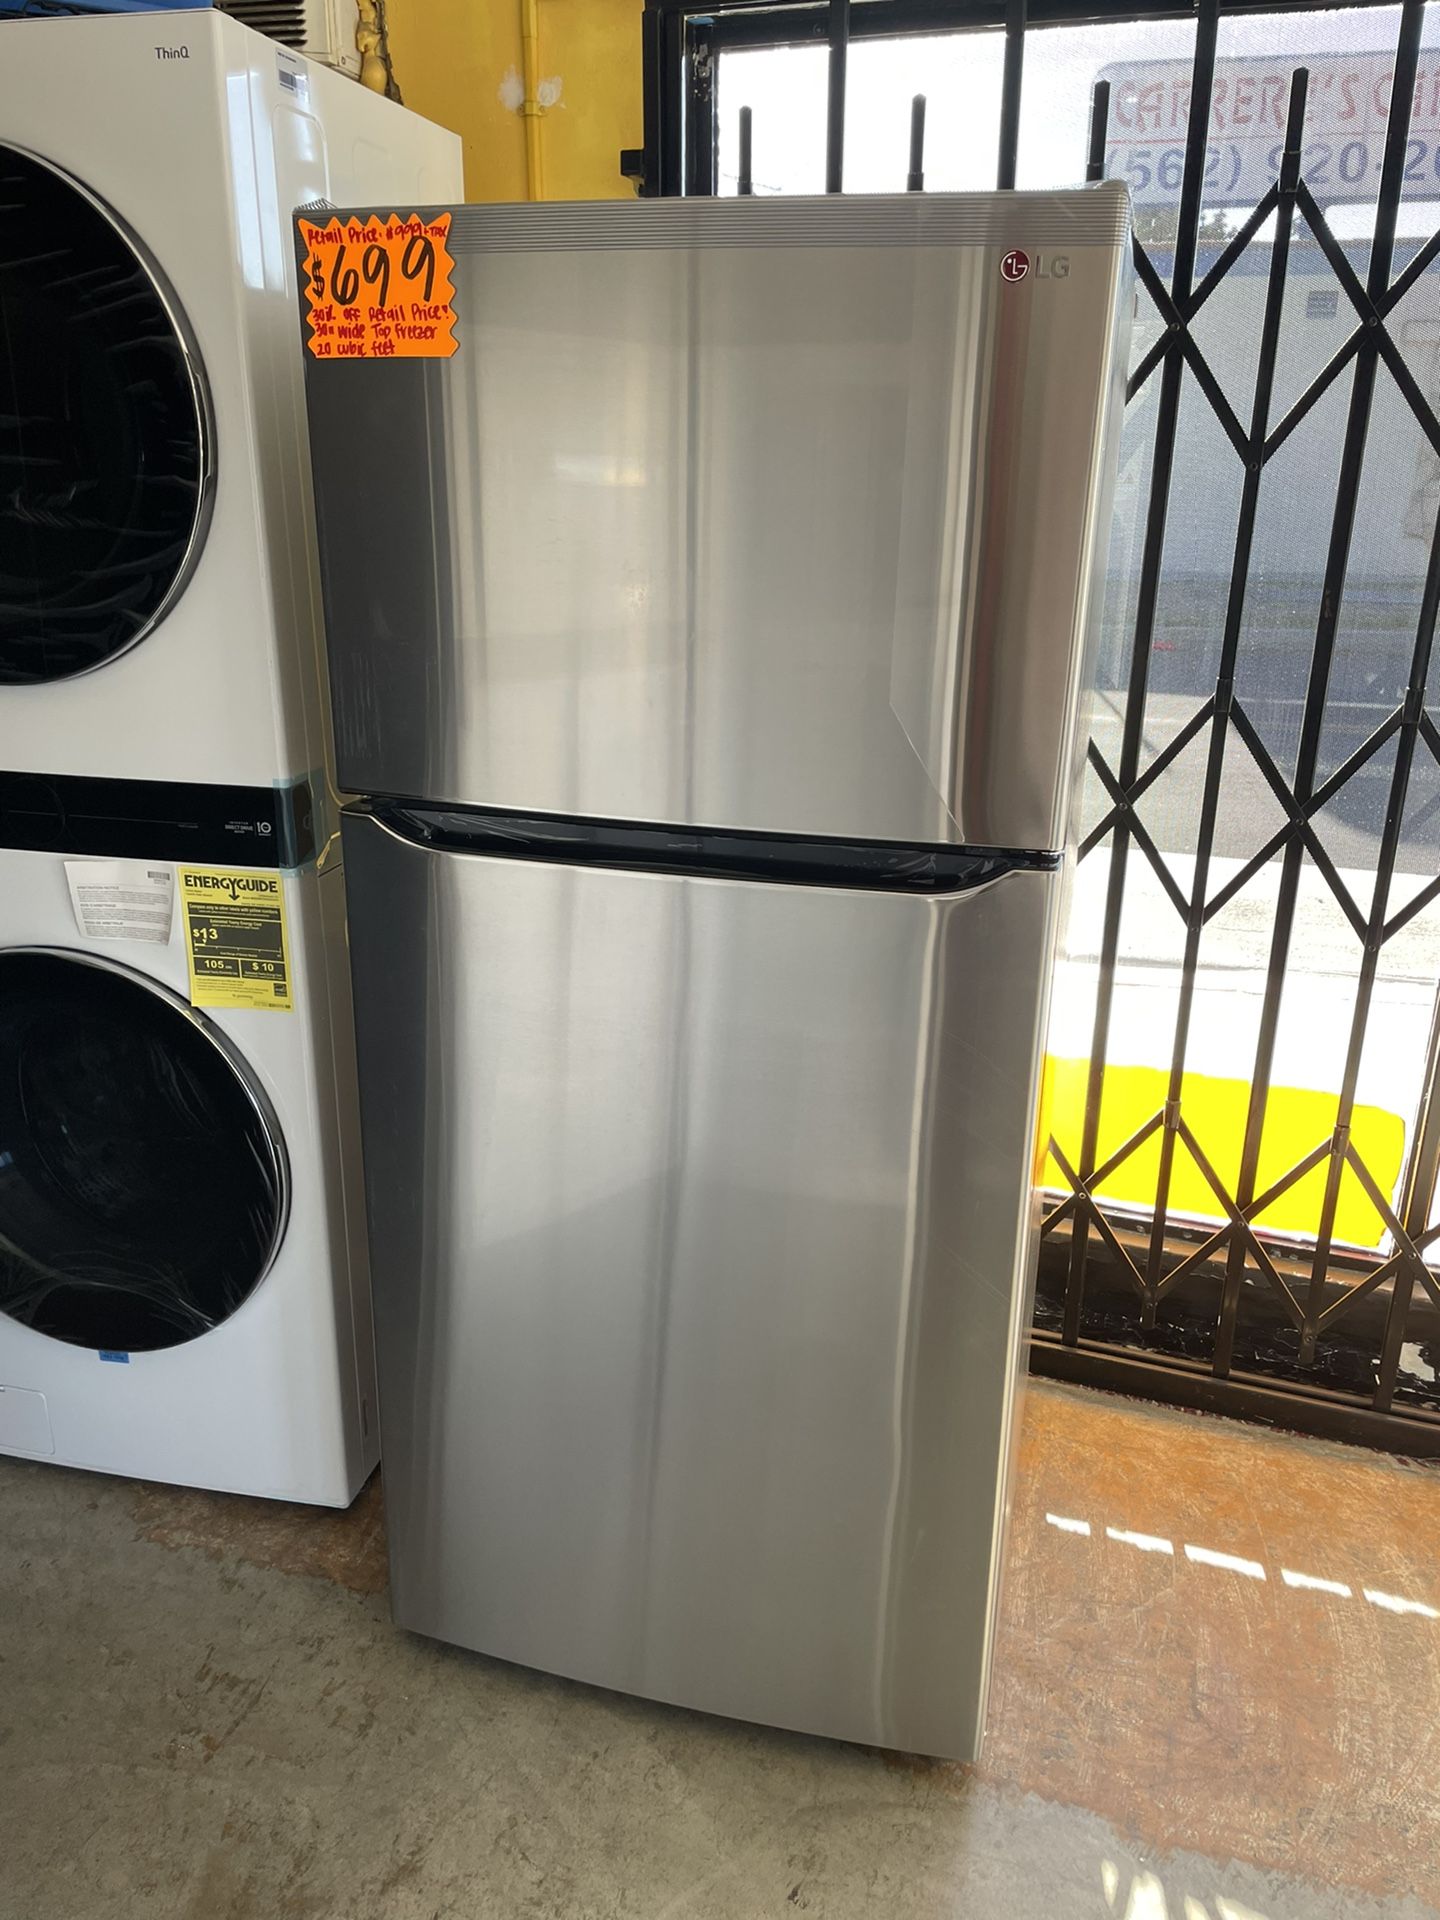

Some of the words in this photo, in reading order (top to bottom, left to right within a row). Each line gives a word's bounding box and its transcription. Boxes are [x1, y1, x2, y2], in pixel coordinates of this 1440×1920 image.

[154, 46, 190, 60] ThinQ
[1035, 255, 1072, 279] LG
[317, 341, 331, 356] 20
[184, 874, 279, 897] ENERGYGUIDE
[192, 927, 218, 940] $13
[204, 959, 224, 969] 105
[261, 963, 274, 972] 10
